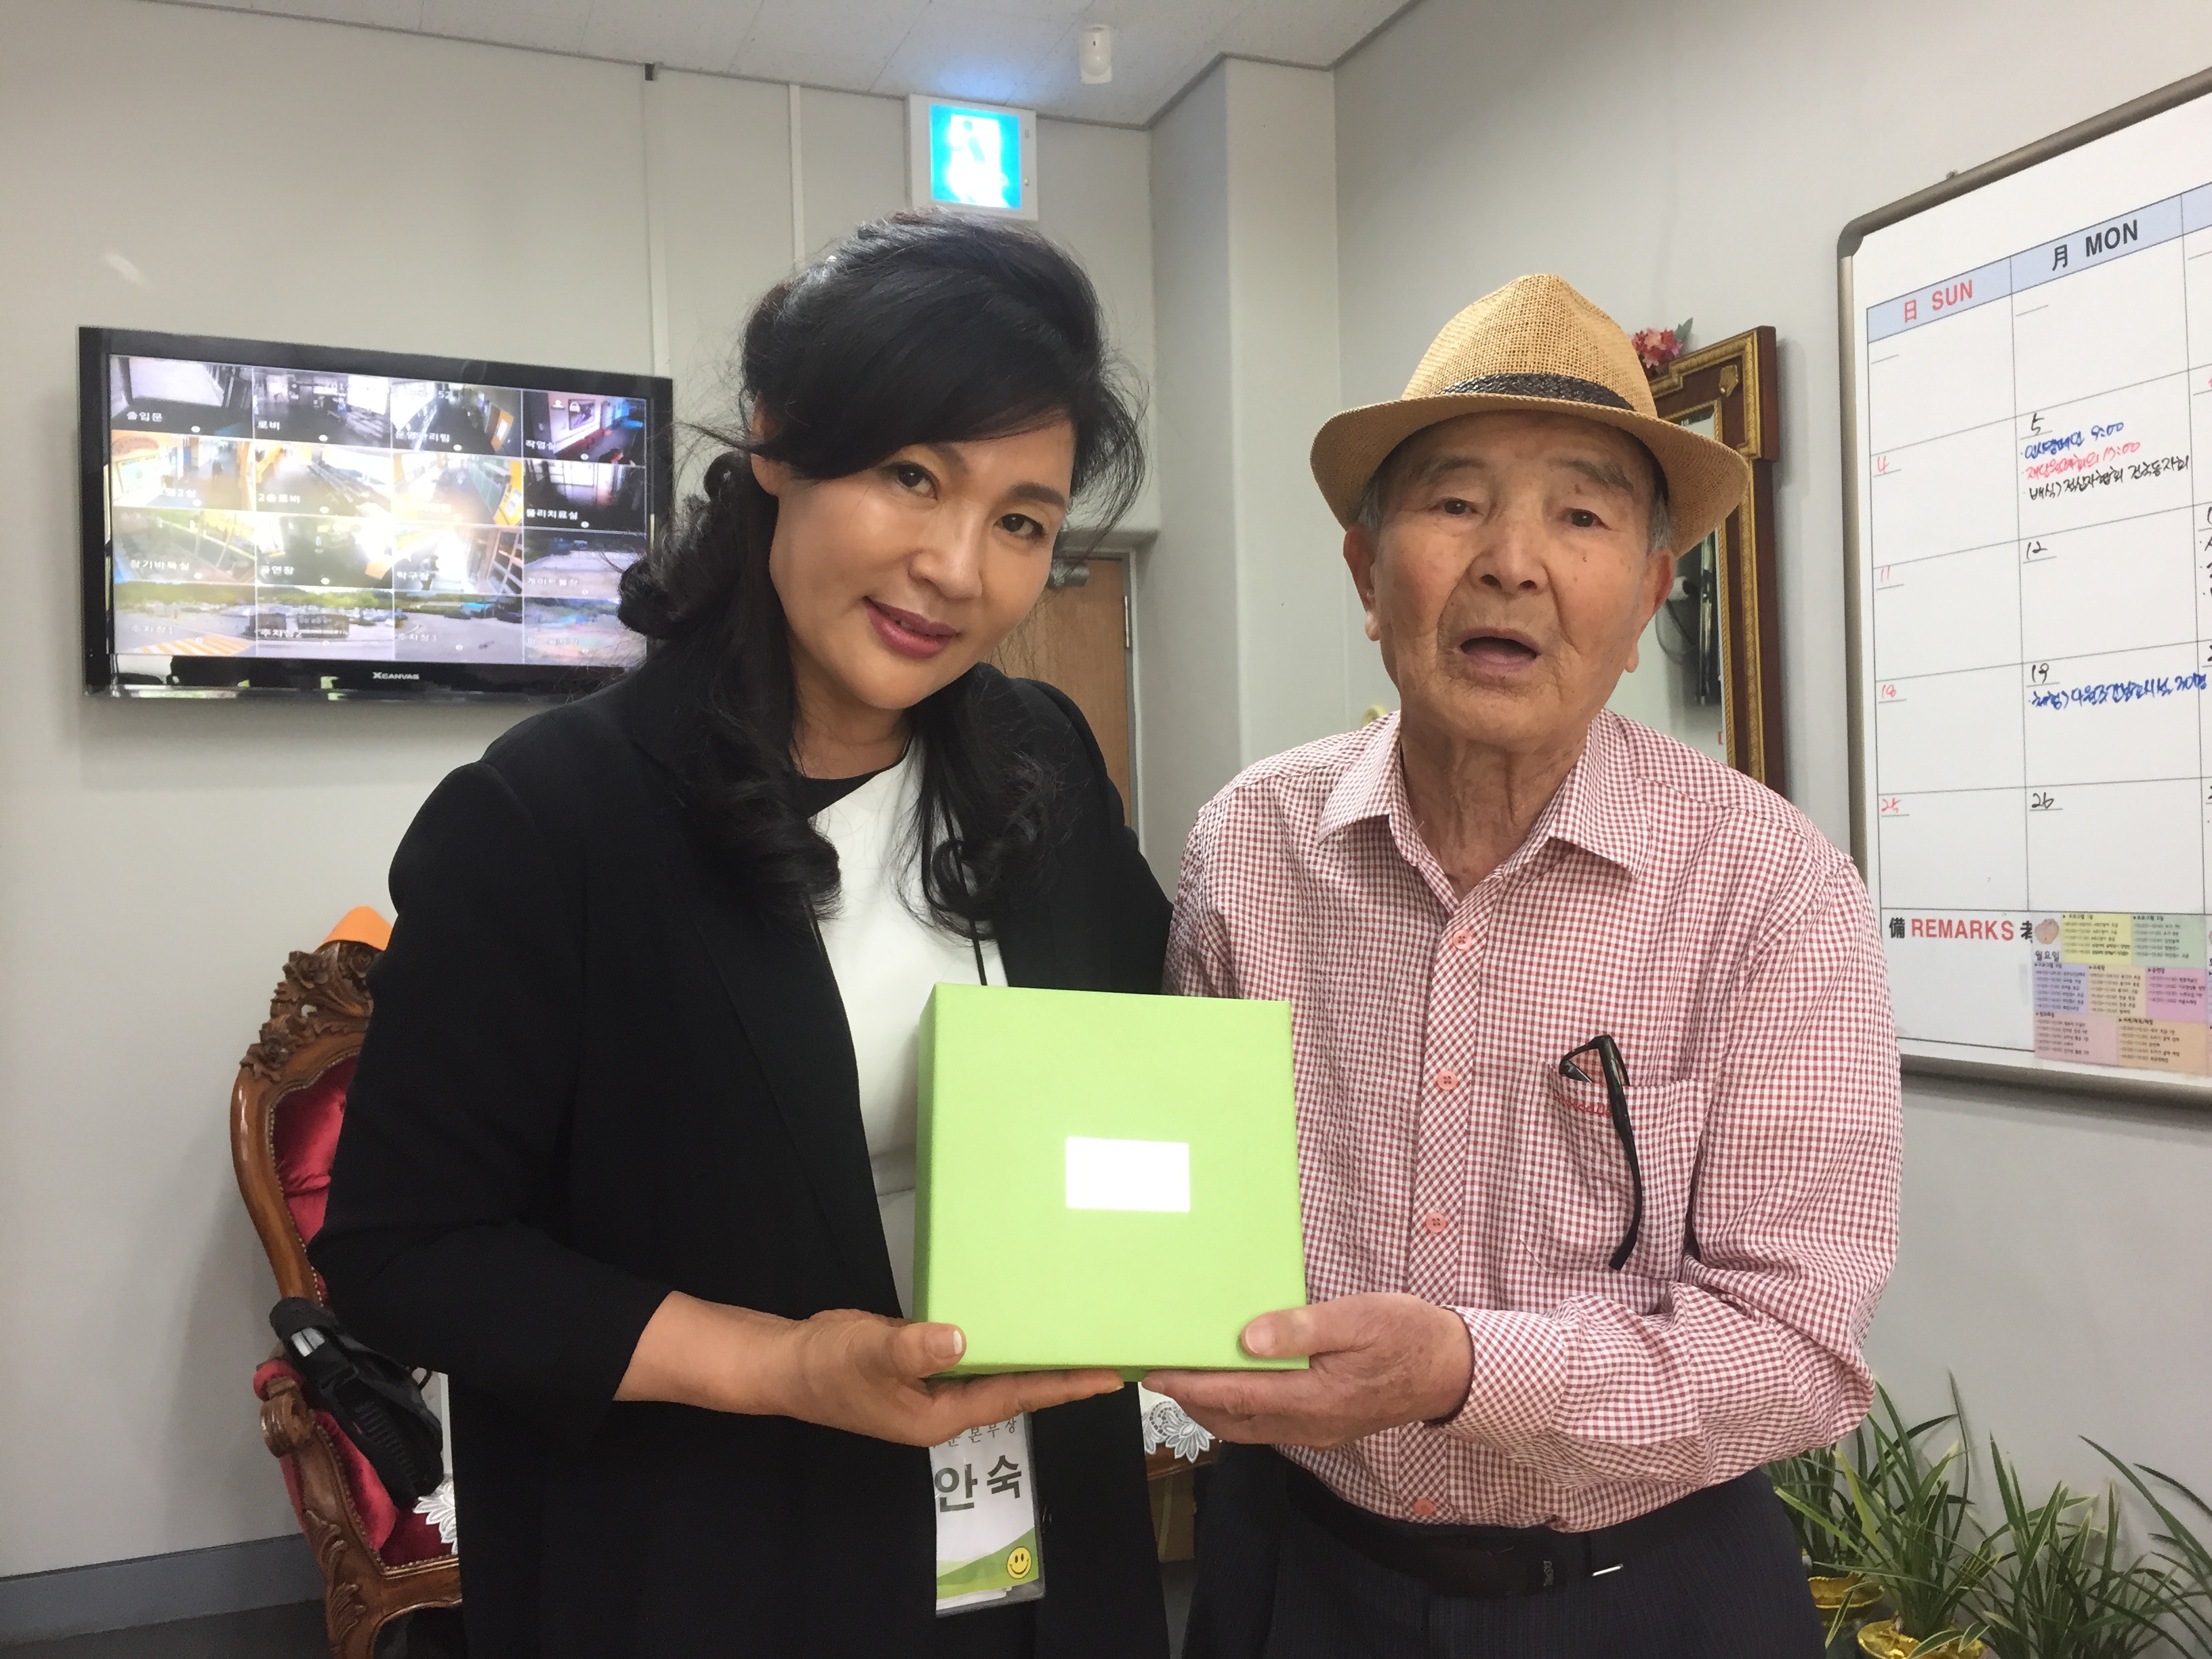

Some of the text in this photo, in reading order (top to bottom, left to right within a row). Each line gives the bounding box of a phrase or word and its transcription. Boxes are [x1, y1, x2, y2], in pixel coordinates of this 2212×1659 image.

[2052, 220, 2138, 270] 月 MON
[1904, 279, 1973, 323] 日 SUN
[2031, 413, 2045, 436] 5
[1877, 455, 1889, 474] 4
[2026, 540, 2047, 560] 12
[1881, 565, 1891, 583] 11
[2032, 663, 2049, 683] 19
[1882, 684, 1896, 699] 18
[1881, 797, 1902, 813] 25
[2032, 792, 2054, 809] 26
[1911, 918, 2015, 941] REMARKS
